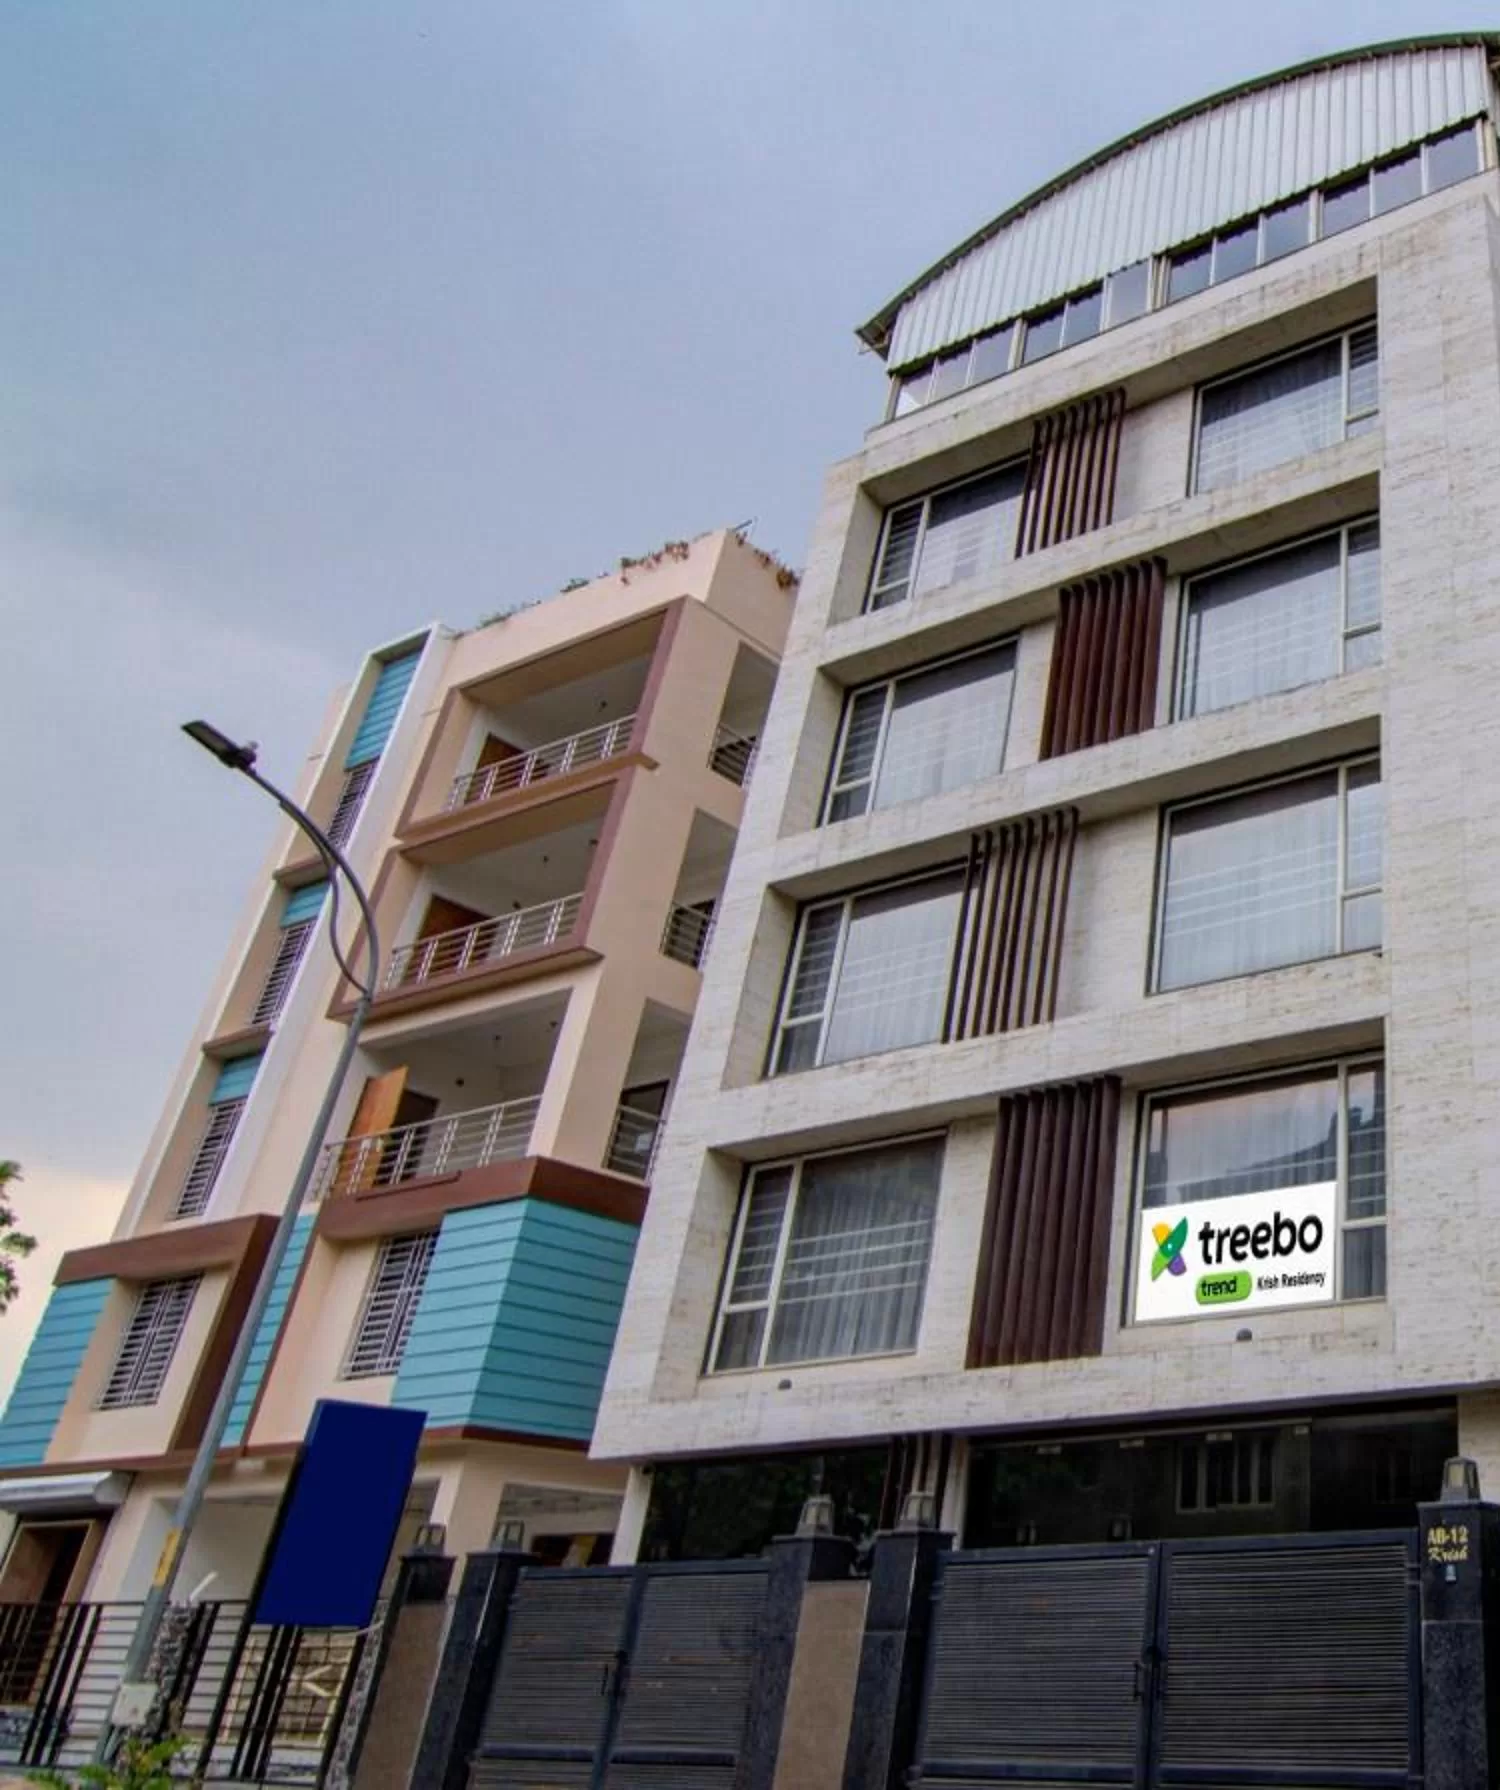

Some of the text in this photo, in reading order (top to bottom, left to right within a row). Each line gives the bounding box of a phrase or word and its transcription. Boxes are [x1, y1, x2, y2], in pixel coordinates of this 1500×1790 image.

[1198, 1210, 1323, 1265] treebo
[1201, 1276, 1238, 1297] trend
[1257, 1270, 1327, 1290] Krish Residency
